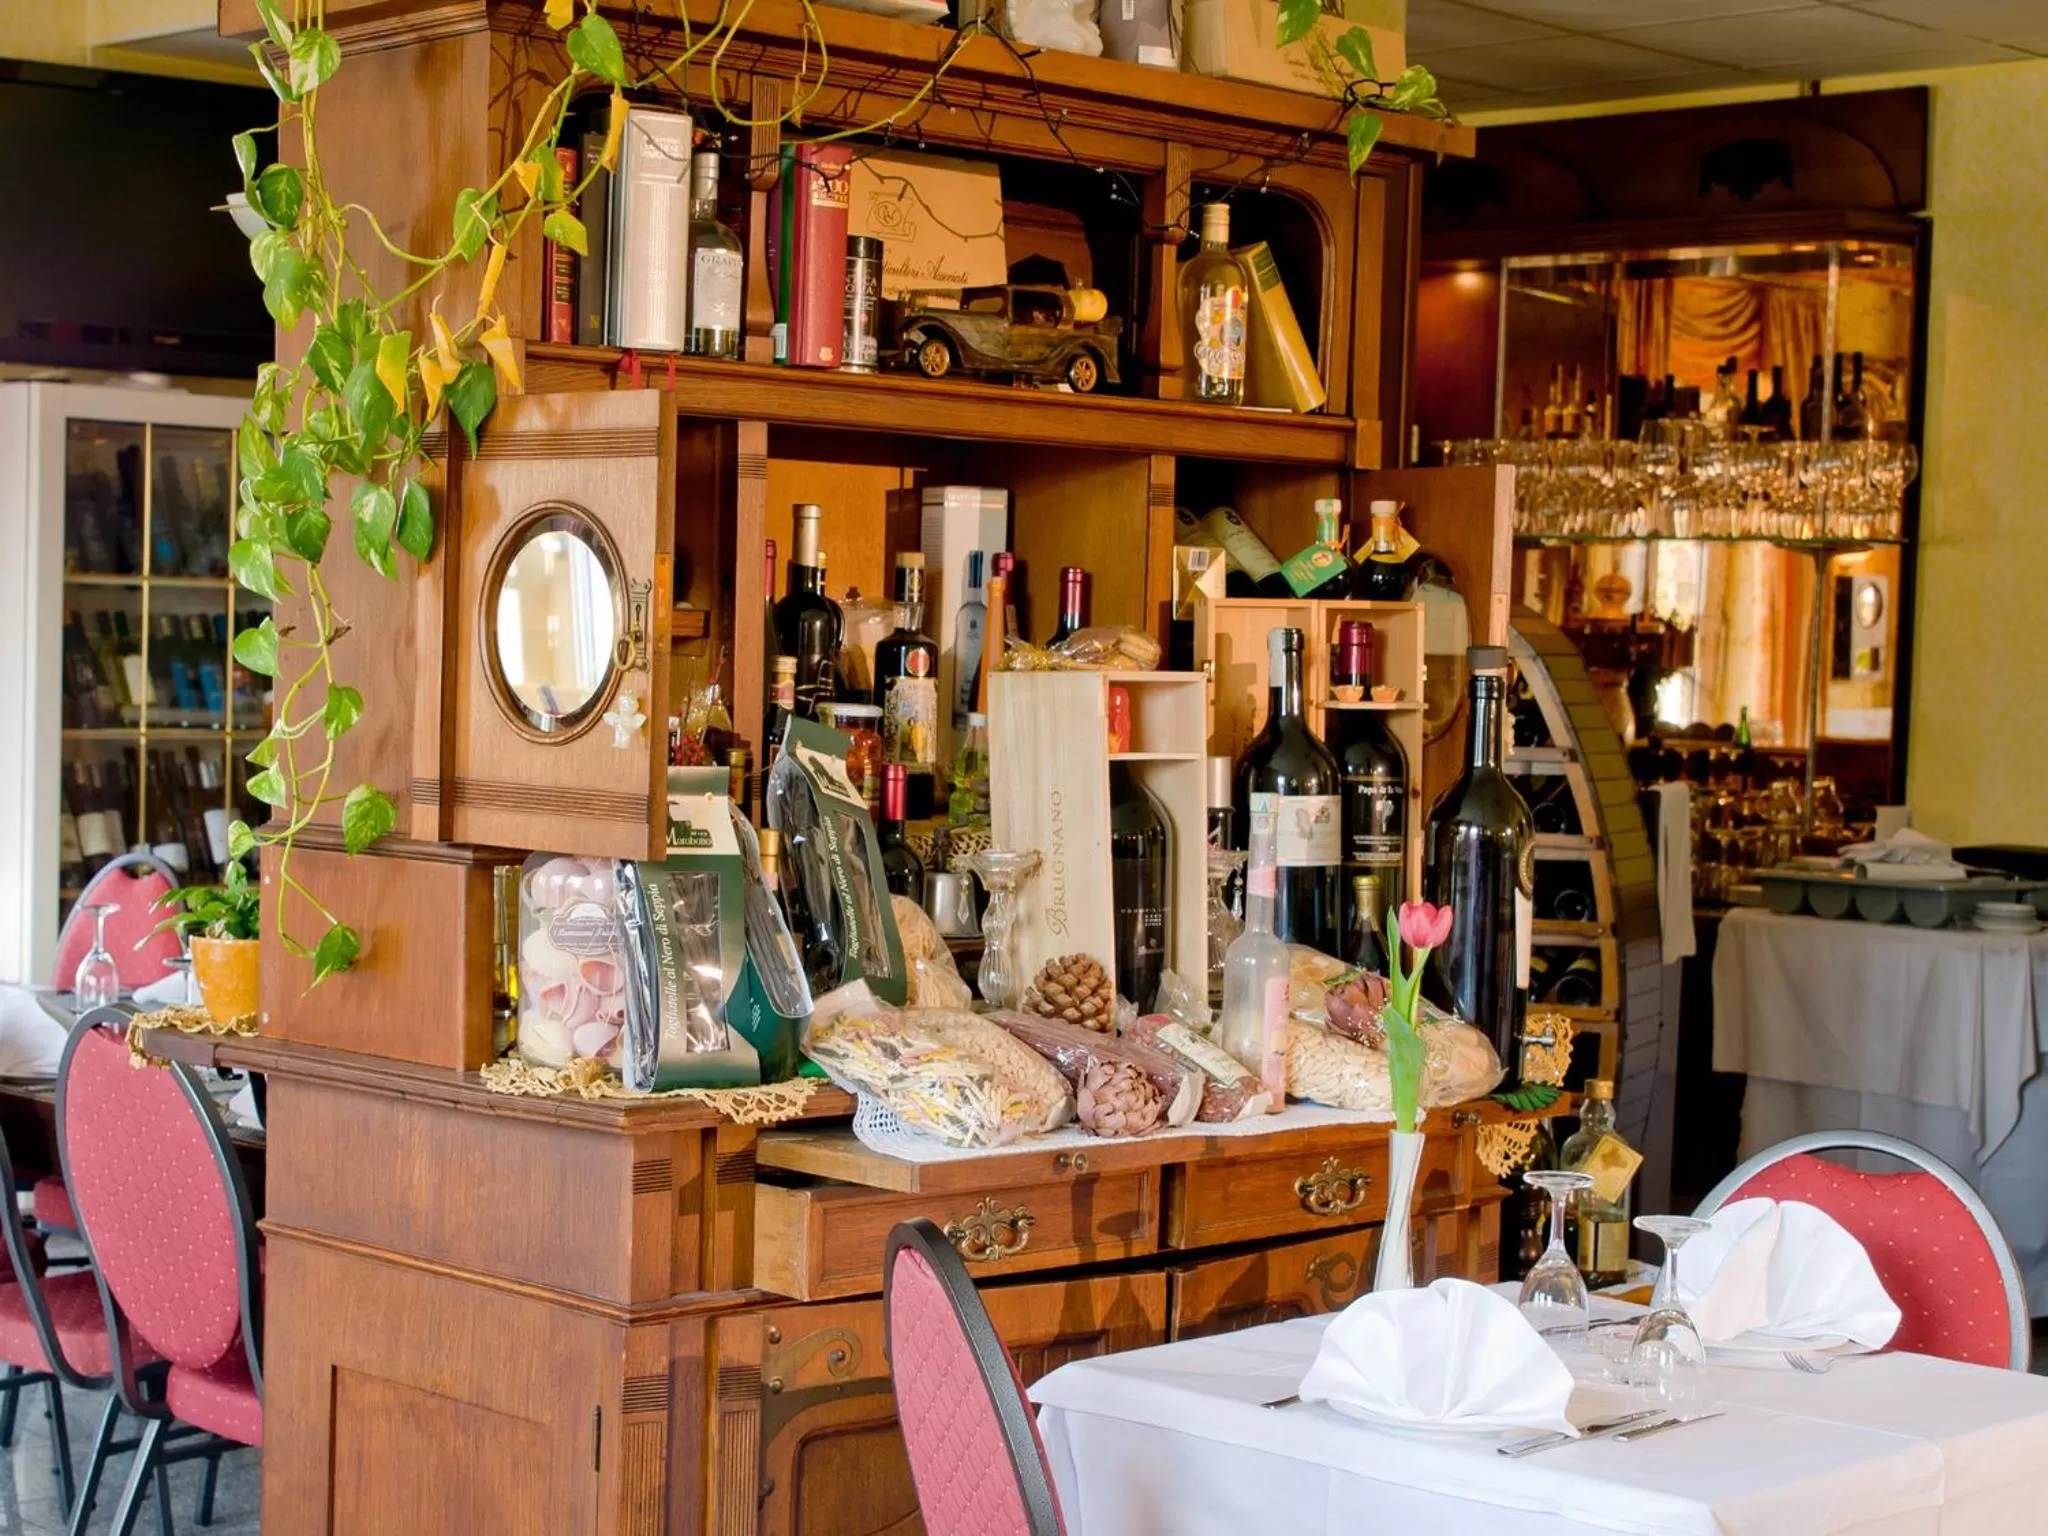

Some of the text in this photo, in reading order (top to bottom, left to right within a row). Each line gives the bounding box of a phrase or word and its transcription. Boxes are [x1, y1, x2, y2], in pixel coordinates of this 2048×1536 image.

[647, 883, 680, 1039] Tagliatelle al Nero di Seppia
